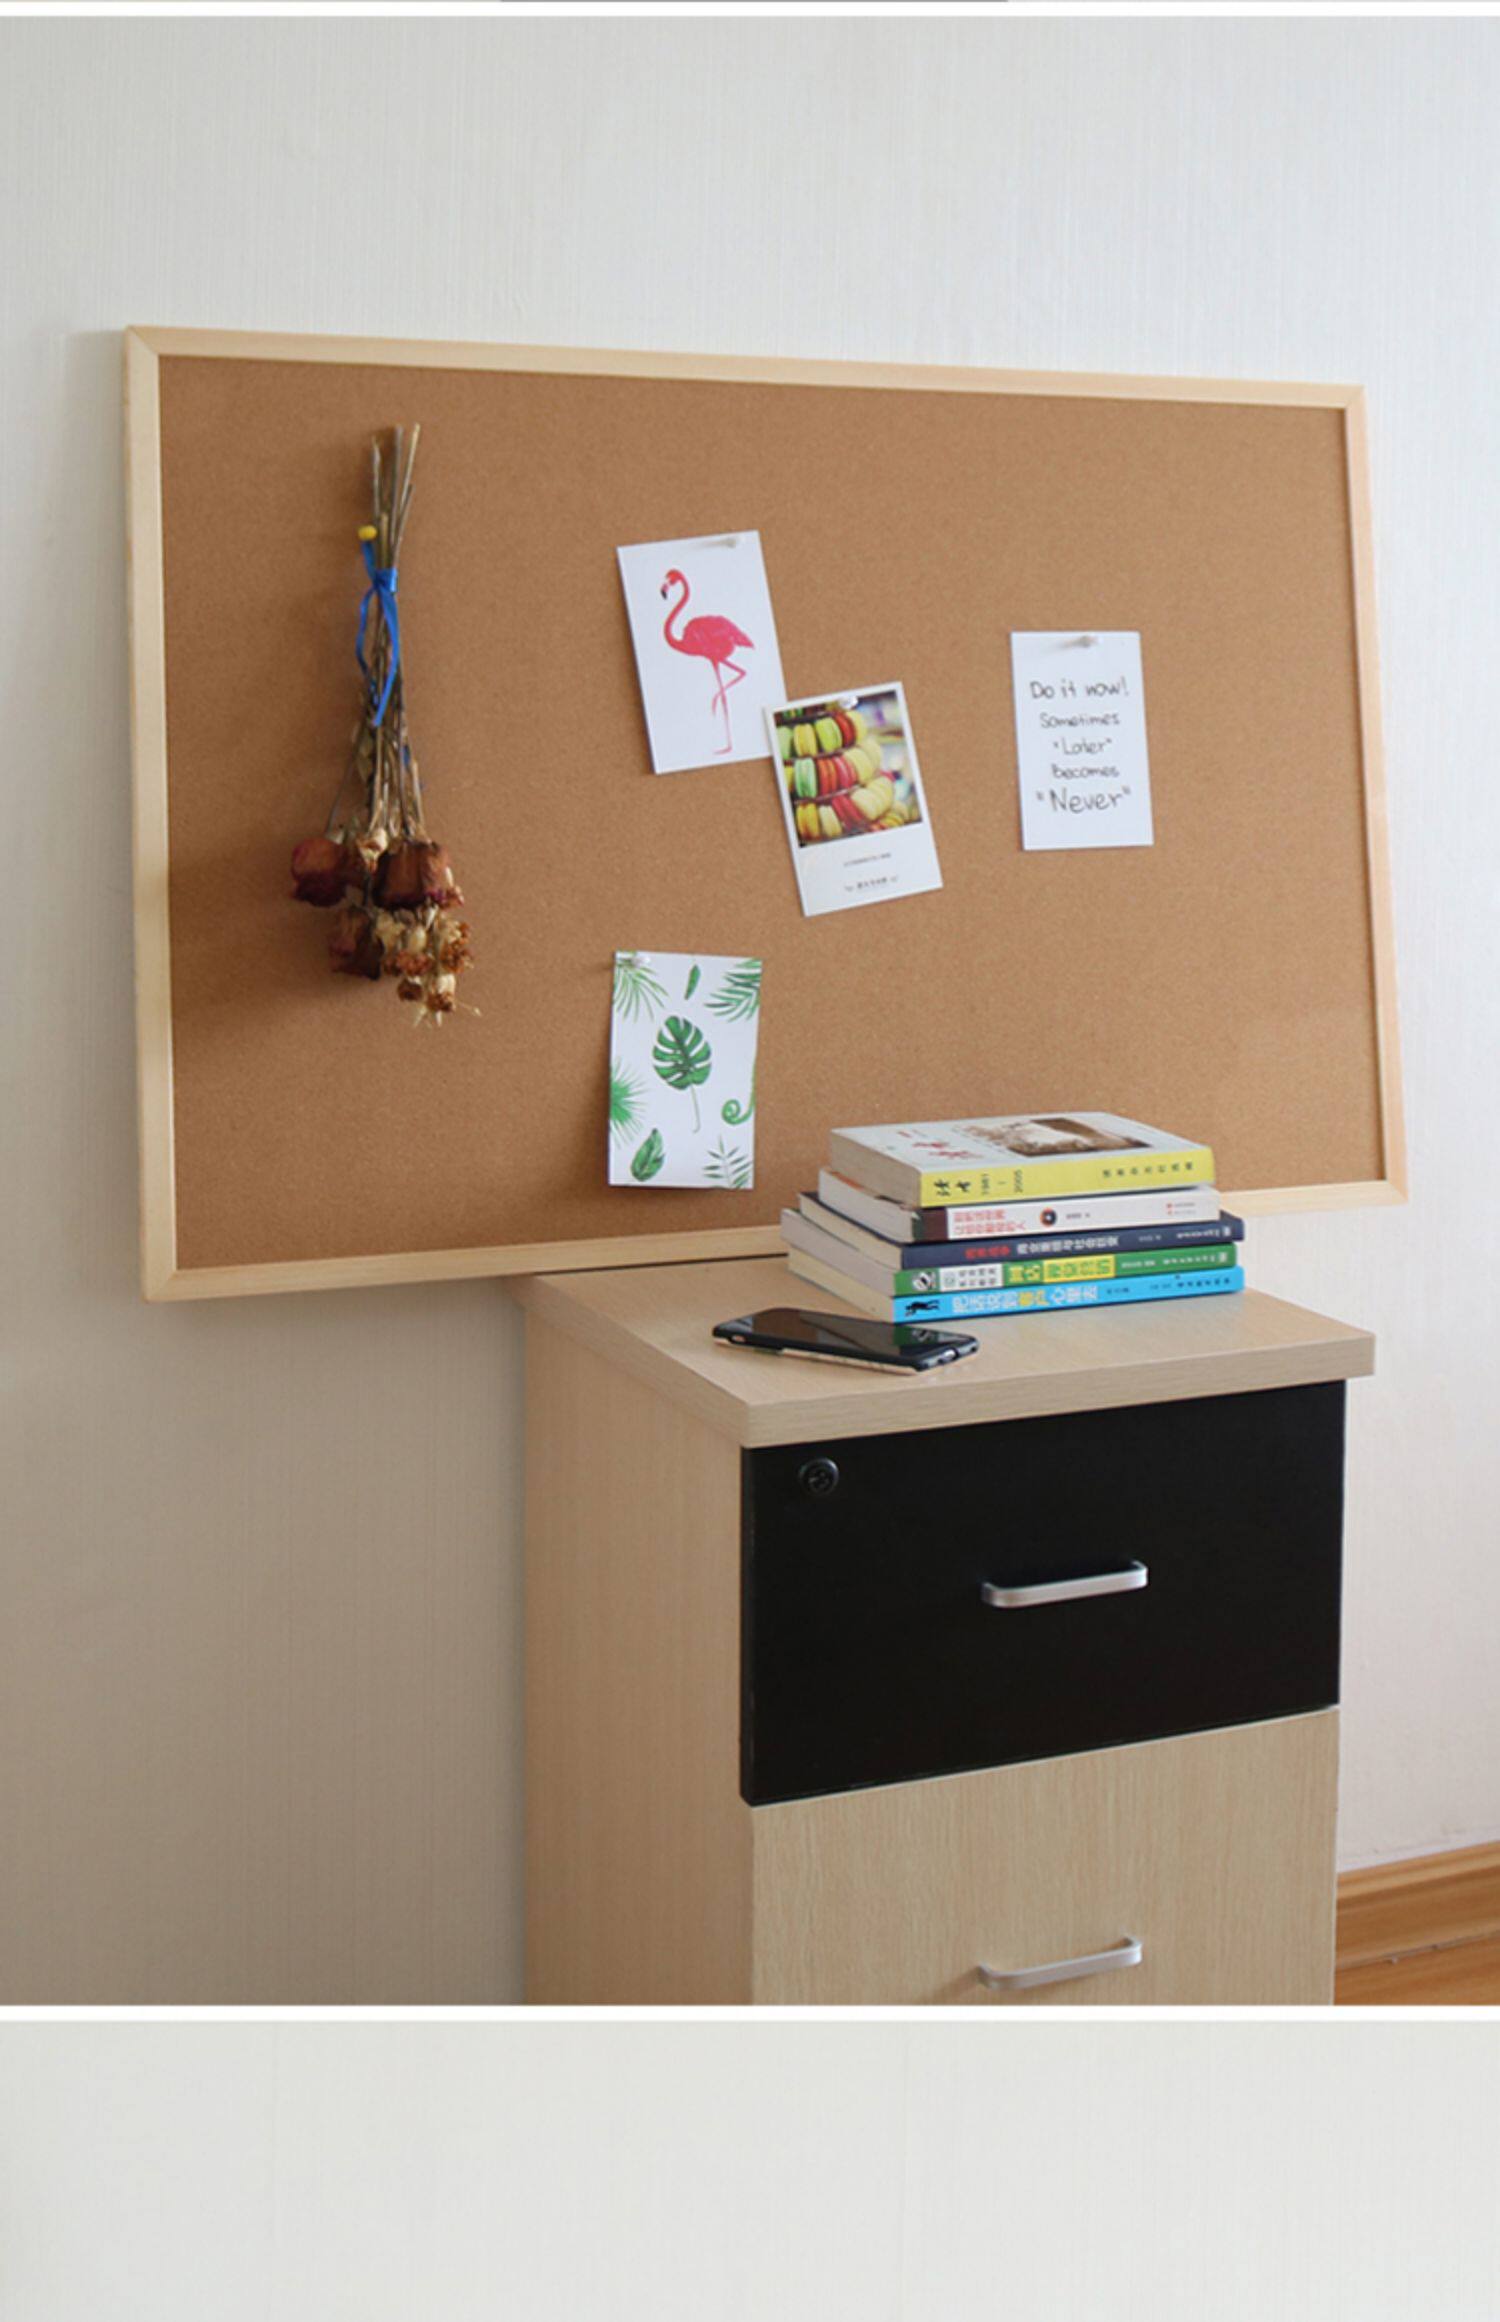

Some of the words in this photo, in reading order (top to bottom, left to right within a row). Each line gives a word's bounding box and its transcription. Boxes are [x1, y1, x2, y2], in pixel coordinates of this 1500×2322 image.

[1030, 682, 1054, 699] Do
[1061, 680, 1076, 698] it
[1086, 676, 1130, 697] now!
[1040, 714, 1120, 728] Sometimes
